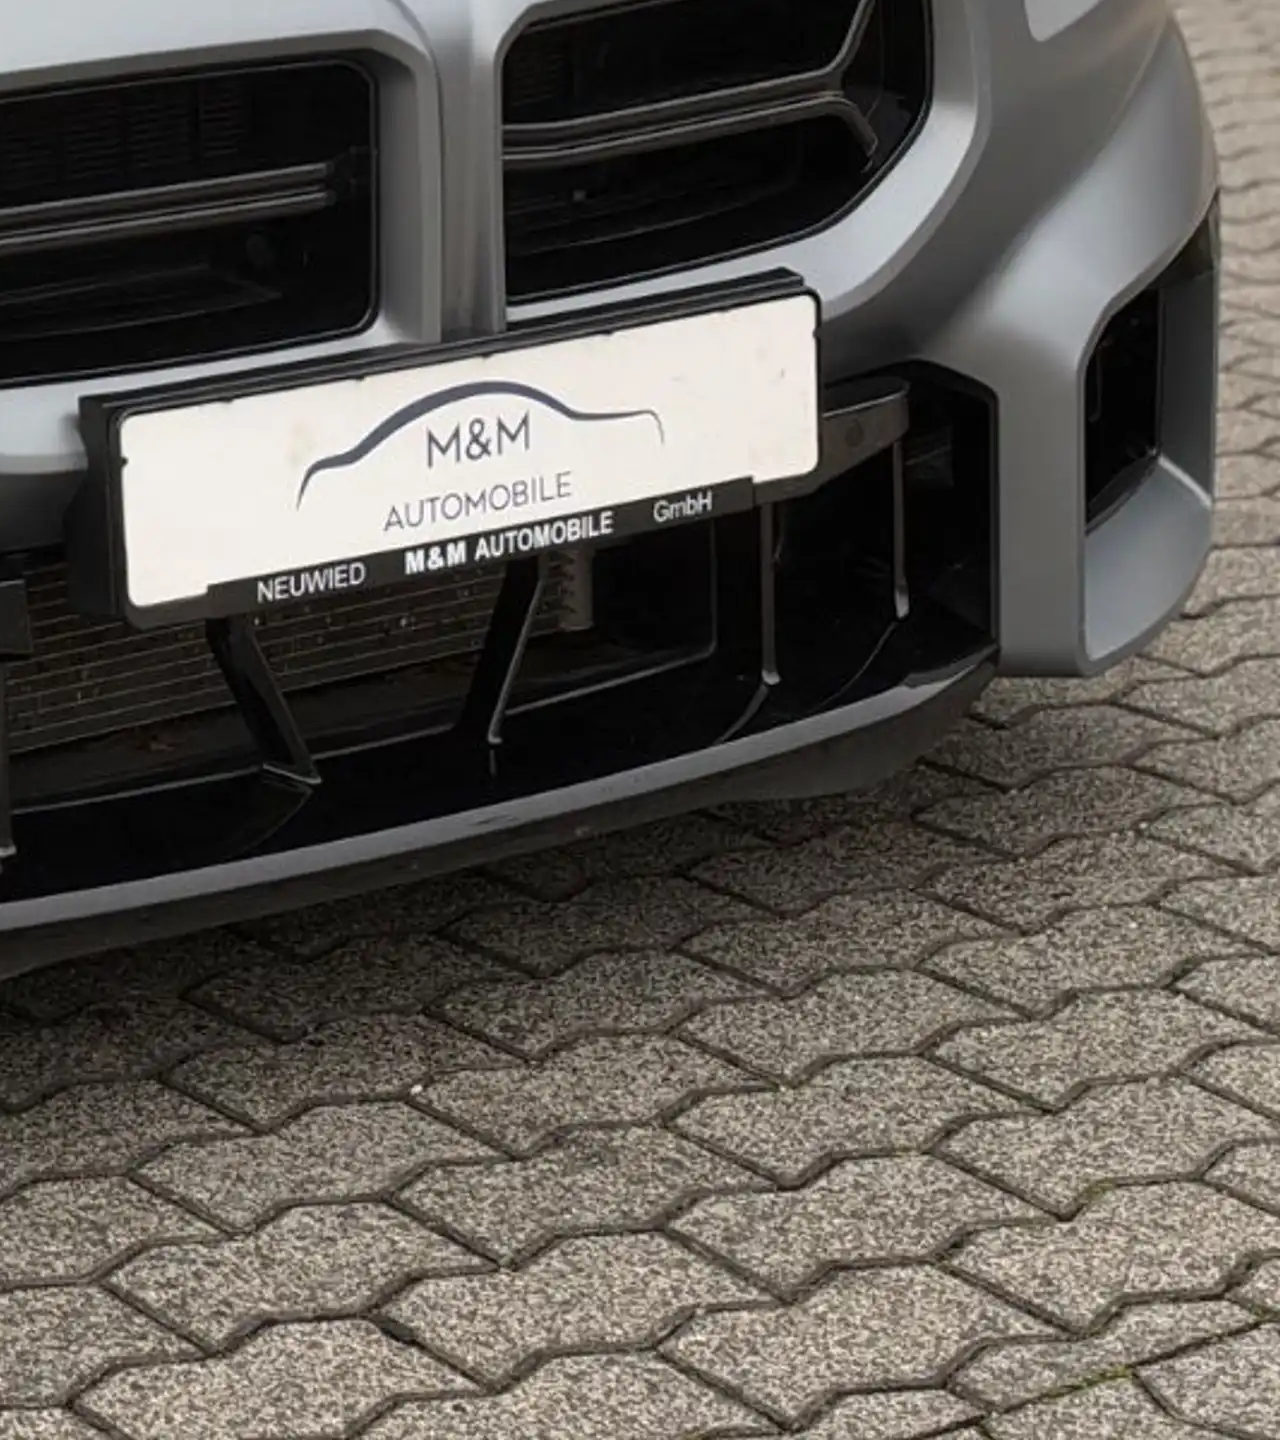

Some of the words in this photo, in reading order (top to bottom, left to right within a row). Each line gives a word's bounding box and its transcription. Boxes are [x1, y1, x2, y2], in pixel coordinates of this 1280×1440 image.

[426, 412, 531, 468] M&M
[383, 472, 572, 532] AUTOMOBILE
[256, 563, 366, 603] NEUWIED
[405, 541, 466, 575] M&M
[474, 511, 614, 561] AUTOMOBILE
[652, 491, 715, 523] GmbH
